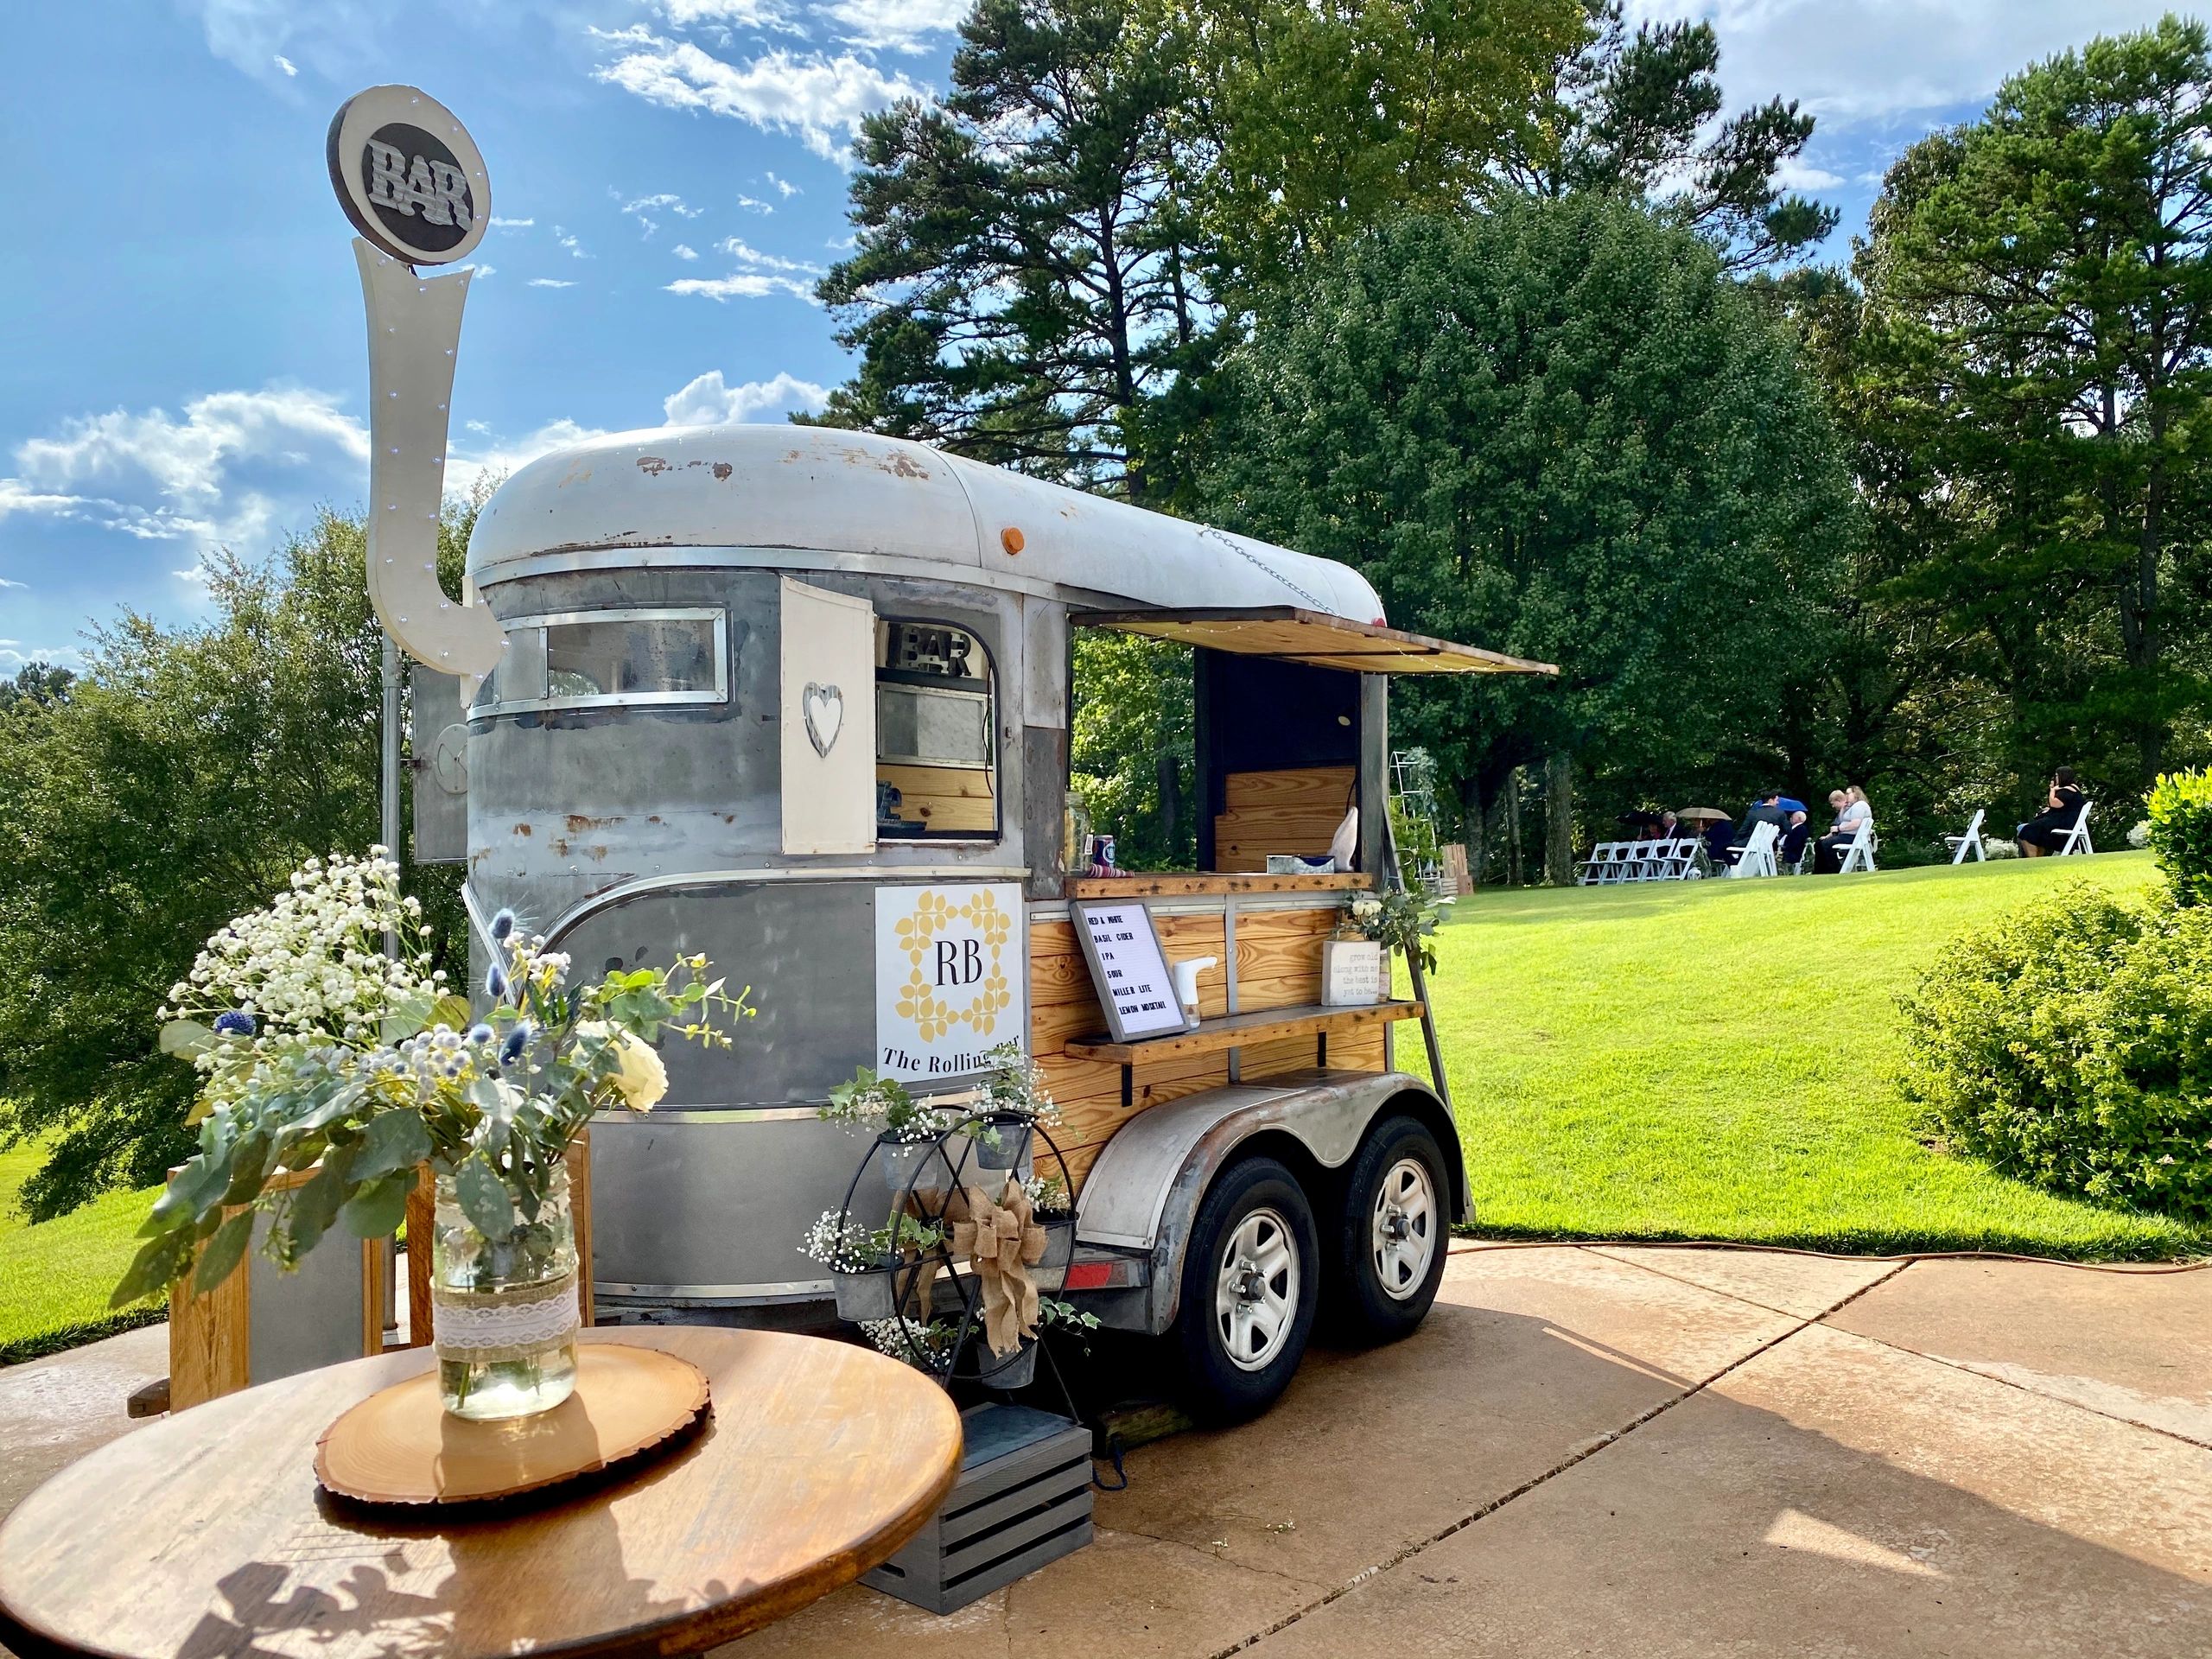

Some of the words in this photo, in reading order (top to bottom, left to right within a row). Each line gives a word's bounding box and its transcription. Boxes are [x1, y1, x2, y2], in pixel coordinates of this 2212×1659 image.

[366, 138, 474, 232] BAR
[893, 624, 972, 676] BAR
[1088, 917, 1099, 925] RED
[1107, 915, 1123, 924] WHITE
[1093, 934, 1112, 944] BASIL
[1116, 932, 1134, 941] CIDER
[935, 938, 983, 986] RB
[1102, 952, 1115, 961] IPA
[1107, 969, 1123, 978] SOUR
[1112, 987, 1135, 996] MILLER
[1138, 984, 1152, 993] LITE
[1119, 1005, 1139, 1014] LEMON
[883, 1046, 921, 1071] The
